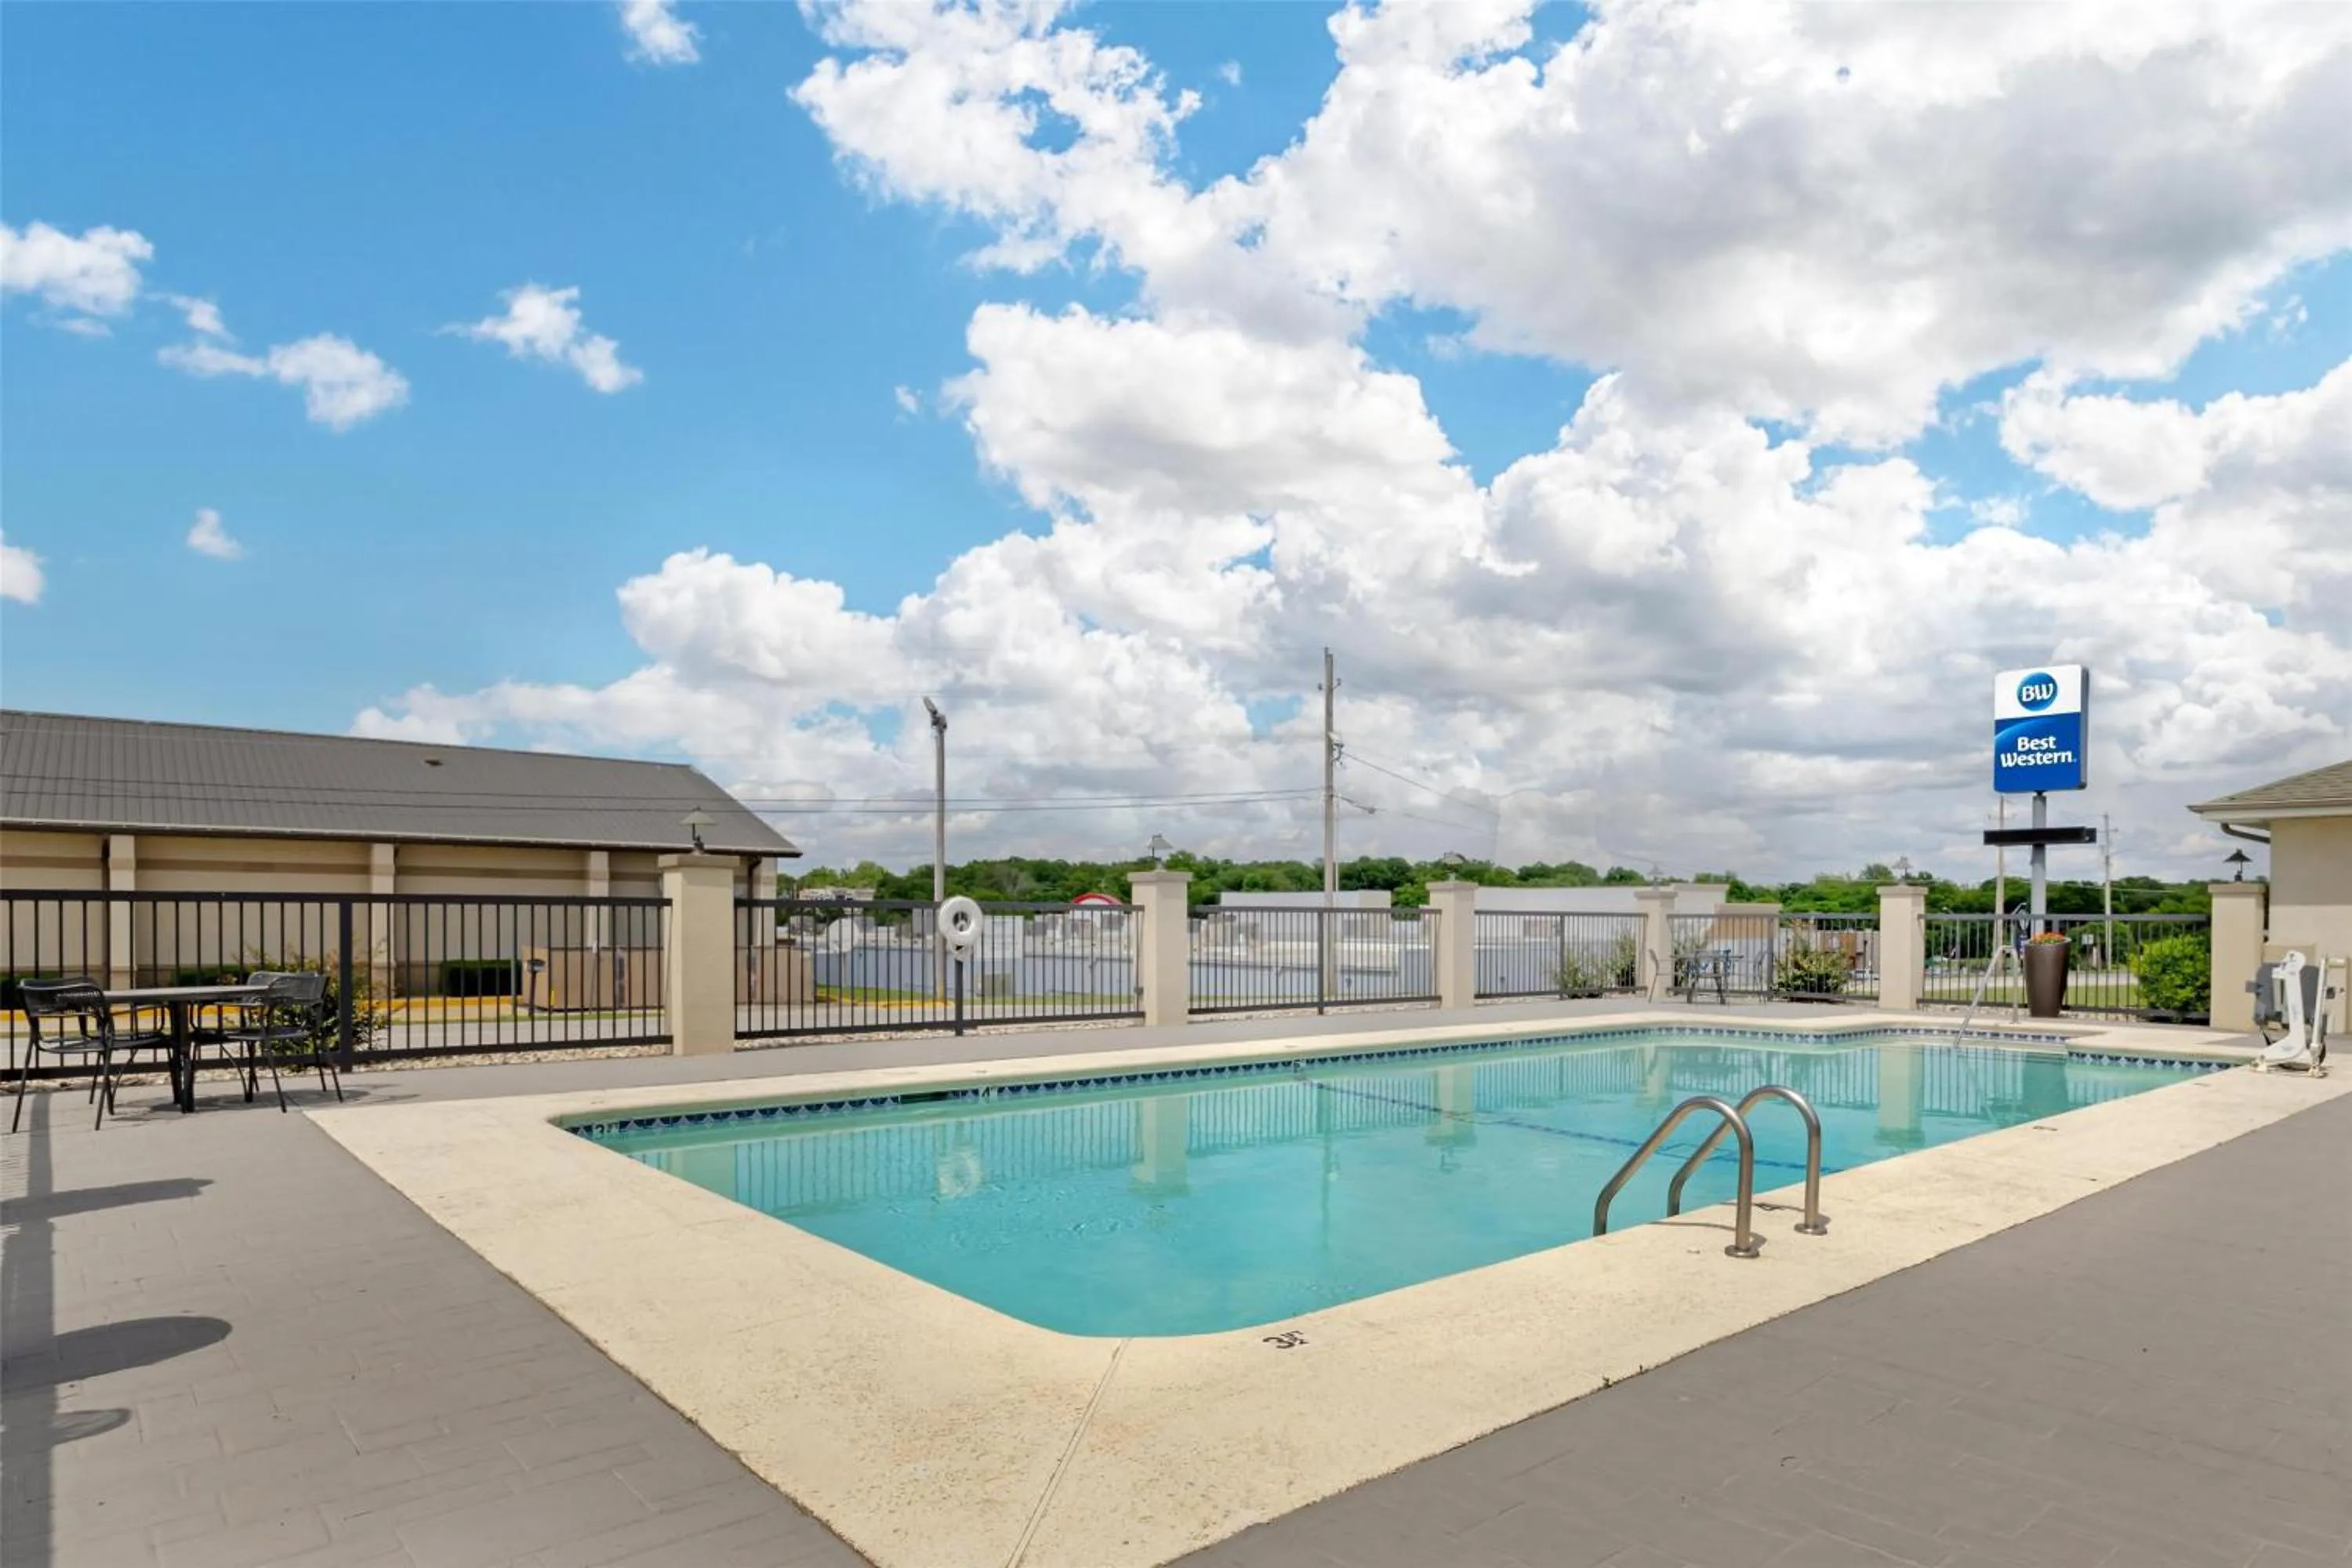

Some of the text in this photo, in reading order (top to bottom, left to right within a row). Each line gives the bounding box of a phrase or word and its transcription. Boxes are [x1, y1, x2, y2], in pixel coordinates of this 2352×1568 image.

[2022, 683, 2053, 702] BW
[2017, 735, 2056, 751] Best
[2000, 750, 2072, 768] Western
